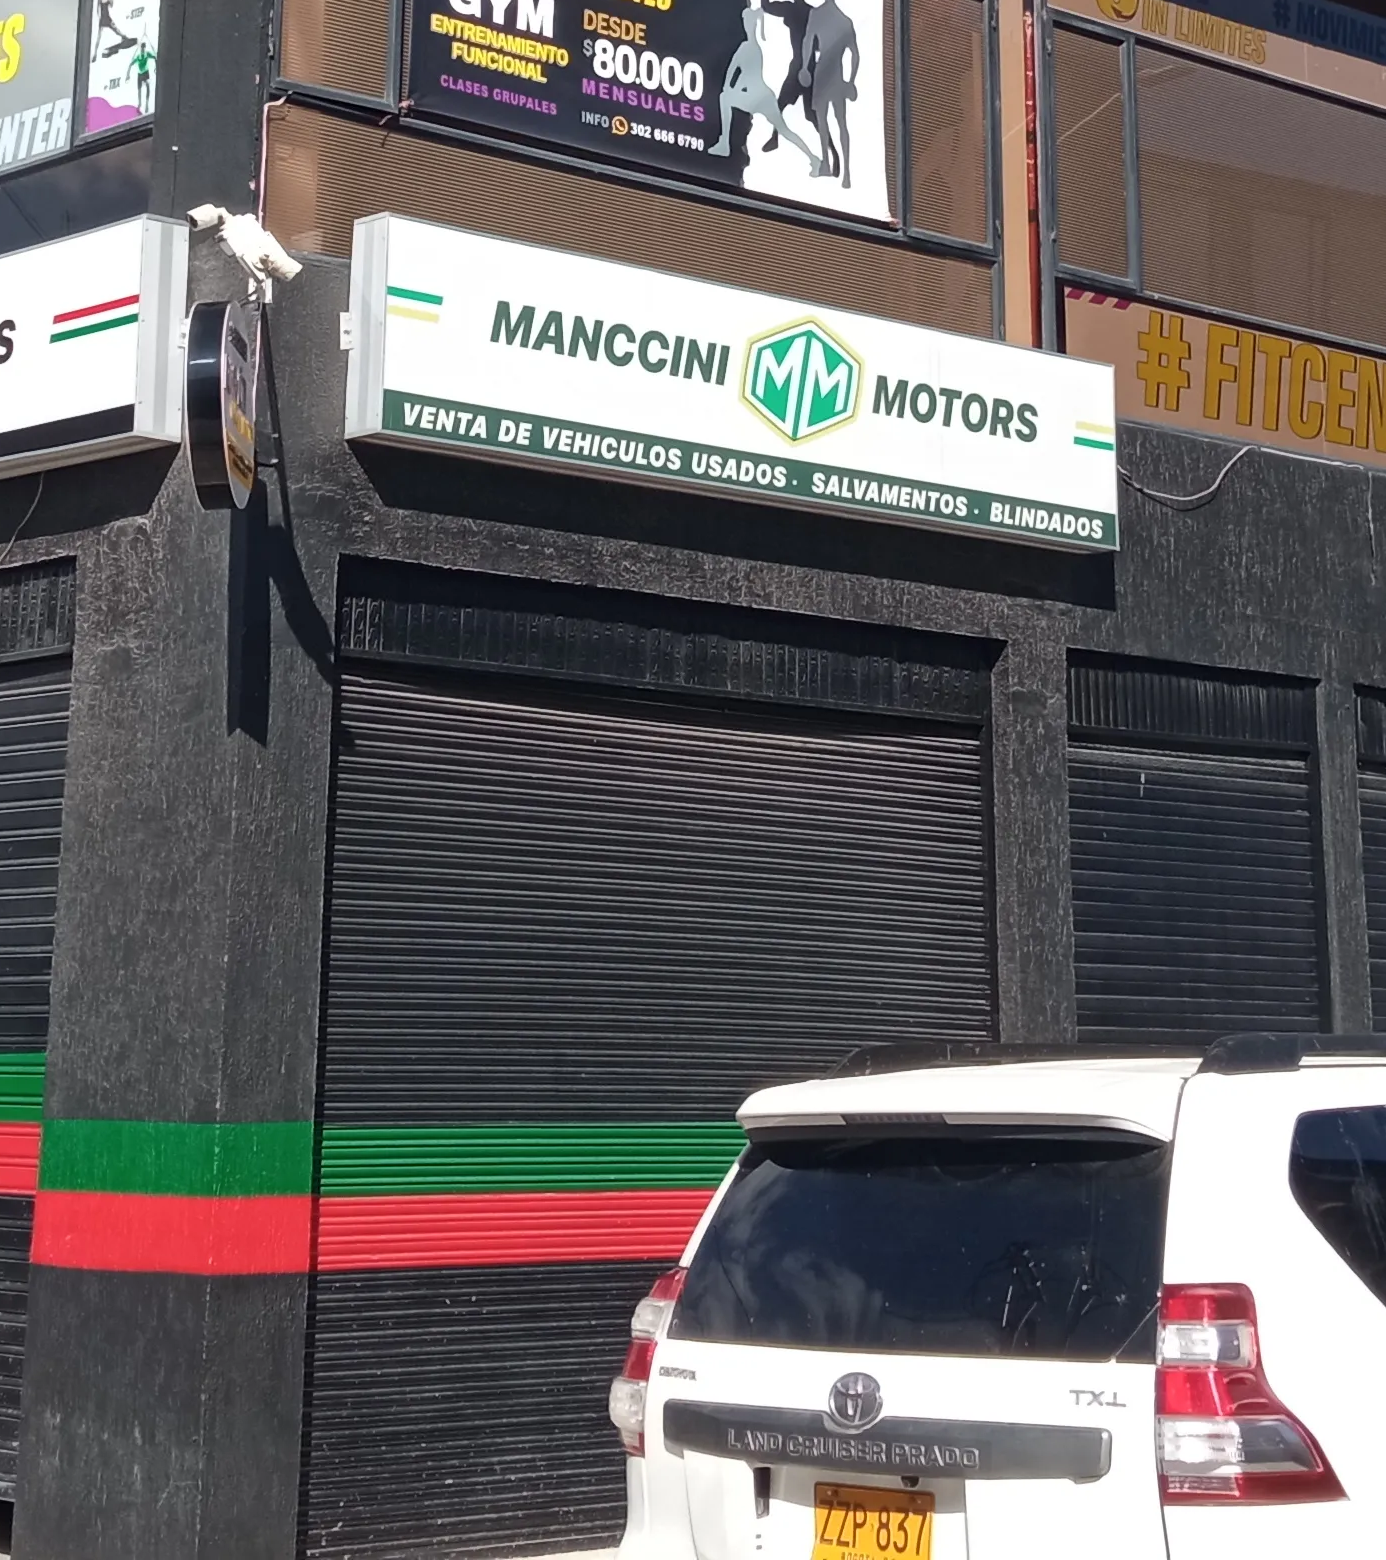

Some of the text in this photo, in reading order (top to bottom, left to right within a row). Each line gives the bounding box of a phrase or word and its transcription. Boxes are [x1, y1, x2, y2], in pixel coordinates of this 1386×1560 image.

[430, 13, 569, 68] ENTRENAMIENTO
[583, 9, 647, 46] DESDE
[1174, 2, 1267, 65] LIMITES
[451, 42, 547, 83] FUNCIONAL
[440, 74, 557, 115] CLASES GRUPALES
[582, 78, 705, 122] MENSUALES
[581, 111, 609, 128] INFO
[630, 122, 651, 139] 302
[677, 132, 705, 151] 6790
[490, 300, 730, 386] MANCCINI
[872, 374, 1039, 442] MOTORS
[403, 402, 1103, 539] VENTA DE VEHICULOS USADOS SALVAMENTOS BLINDADOS
[727, 1428, 979, 1470] LAND CRUISER PRADO
